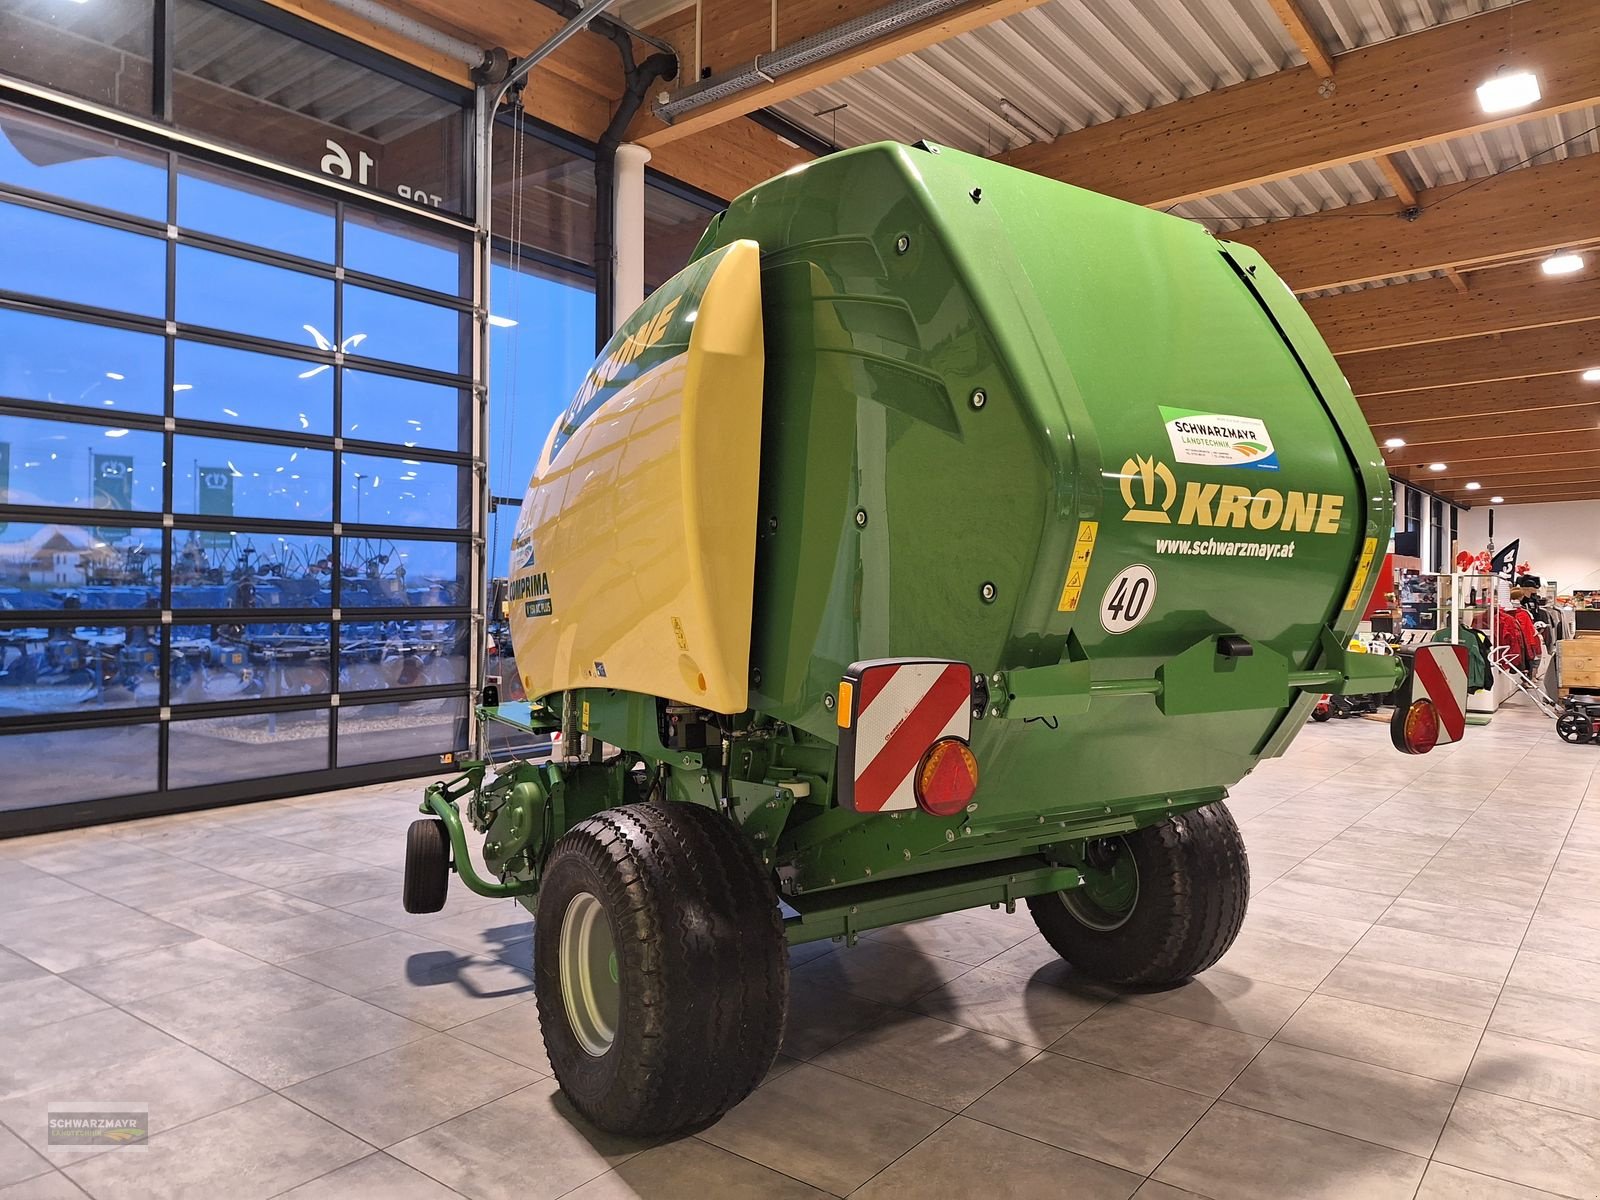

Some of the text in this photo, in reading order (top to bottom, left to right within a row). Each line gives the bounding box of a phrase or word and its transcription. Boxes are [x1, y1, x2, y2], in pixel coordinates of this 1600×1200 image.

[1175, 421, 1257, 440] SCHWARZMAYR
[1181, 435, 1231, 448] LANDTECHNIK
[1177, 481, 1345, 534] KRONE
[1155, 537, 1296, 561] www.schwarzmayr.at
[1107, 576, 1149, 622] 40
